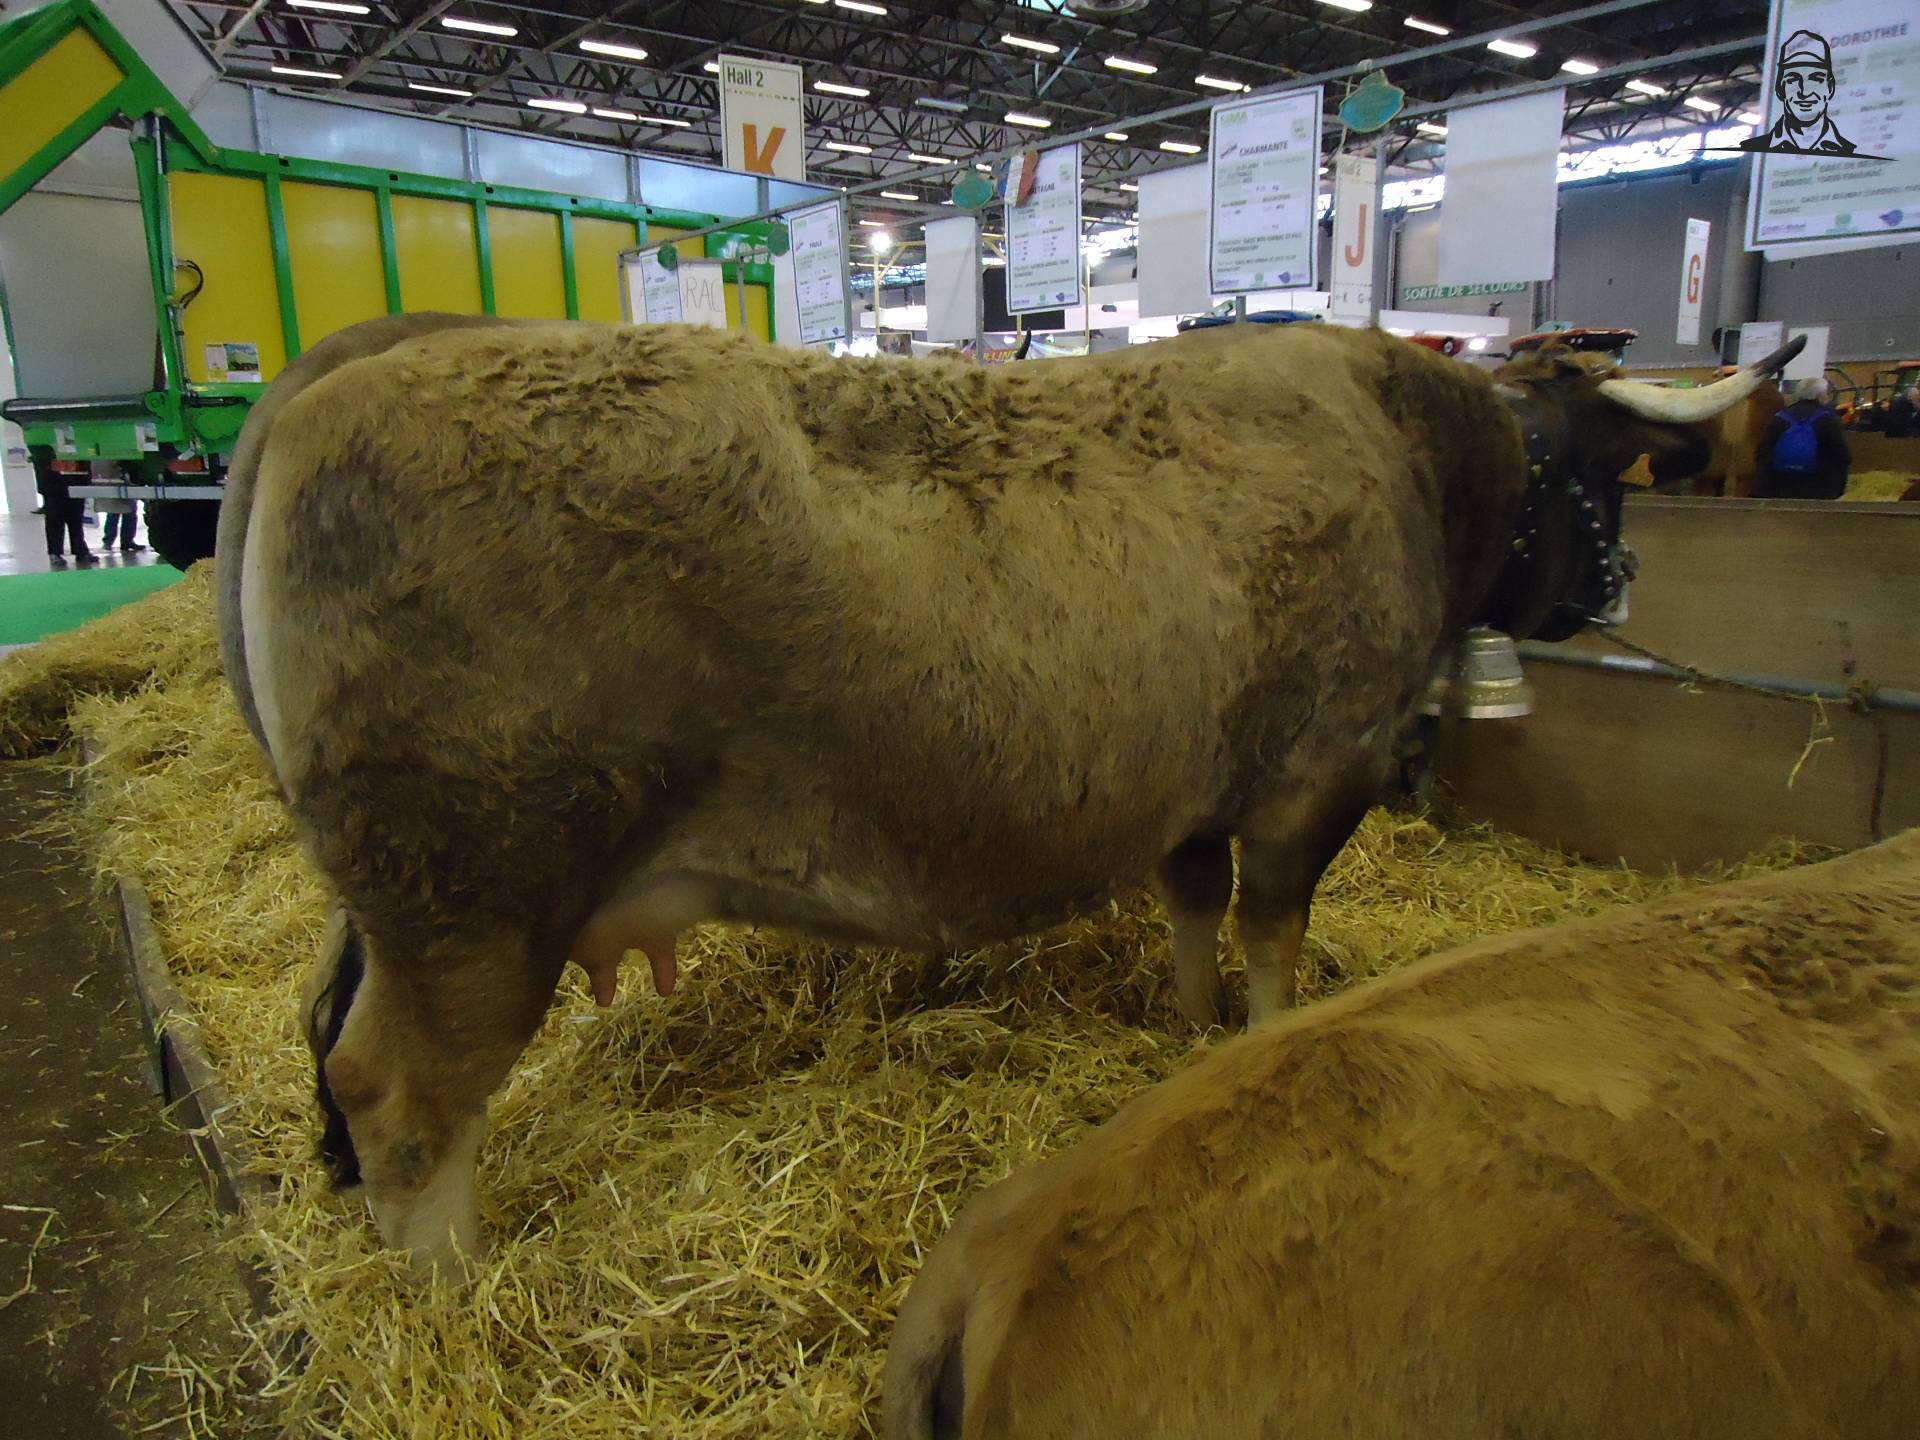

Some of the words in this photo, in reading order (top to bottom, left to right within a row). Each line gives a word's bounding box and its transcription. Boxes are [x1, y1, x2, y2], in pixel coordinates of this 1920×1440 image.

[1830, 22, 1909, 49] DOROTHEE
[727, 66, 752, 86] Hall
[756, 71, 764, 88] 2
[742, 122, 786, 176] K
[1240, 140, 1288, 157] CHARMANTE
[1345, 203, 1367, 267] J
[1405, 287, 1444, 301] SORTIE
[1448, 285, 1463, 297] DE
[1468, 281, 1526, 296] SECOURS
[1687, 254, 1700, 304] G
